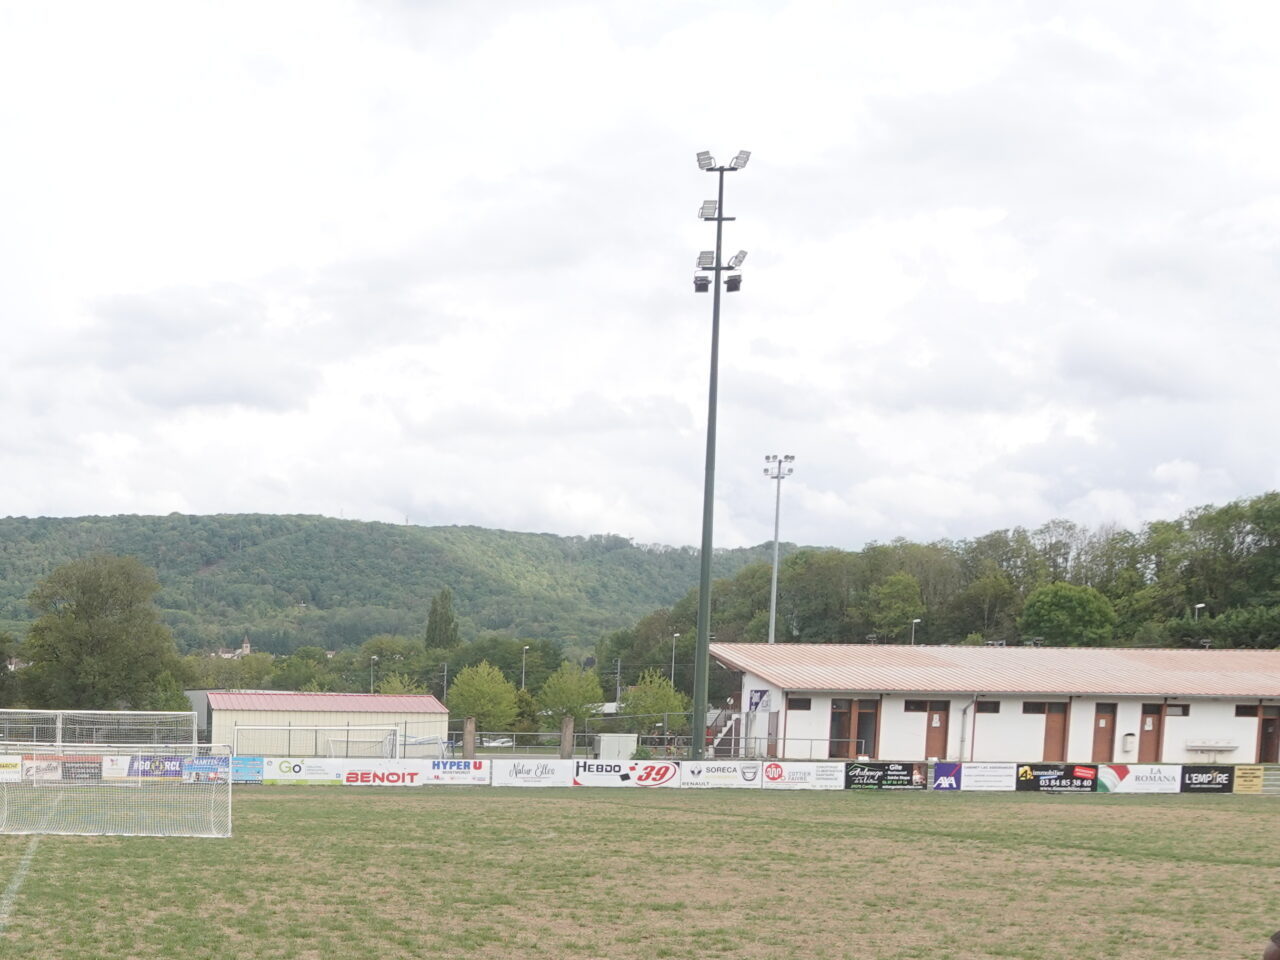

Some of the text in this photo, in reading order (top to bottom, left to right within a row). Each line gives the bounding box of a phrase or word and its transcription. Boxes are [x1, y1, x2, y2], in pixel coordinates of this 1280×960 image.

[432, 761, 482, 770] HYPER U
[346, 773, 419, 783] BENOIT
[637, 765, 670, 782] 39
[933, 776, 957, 788] AXA
